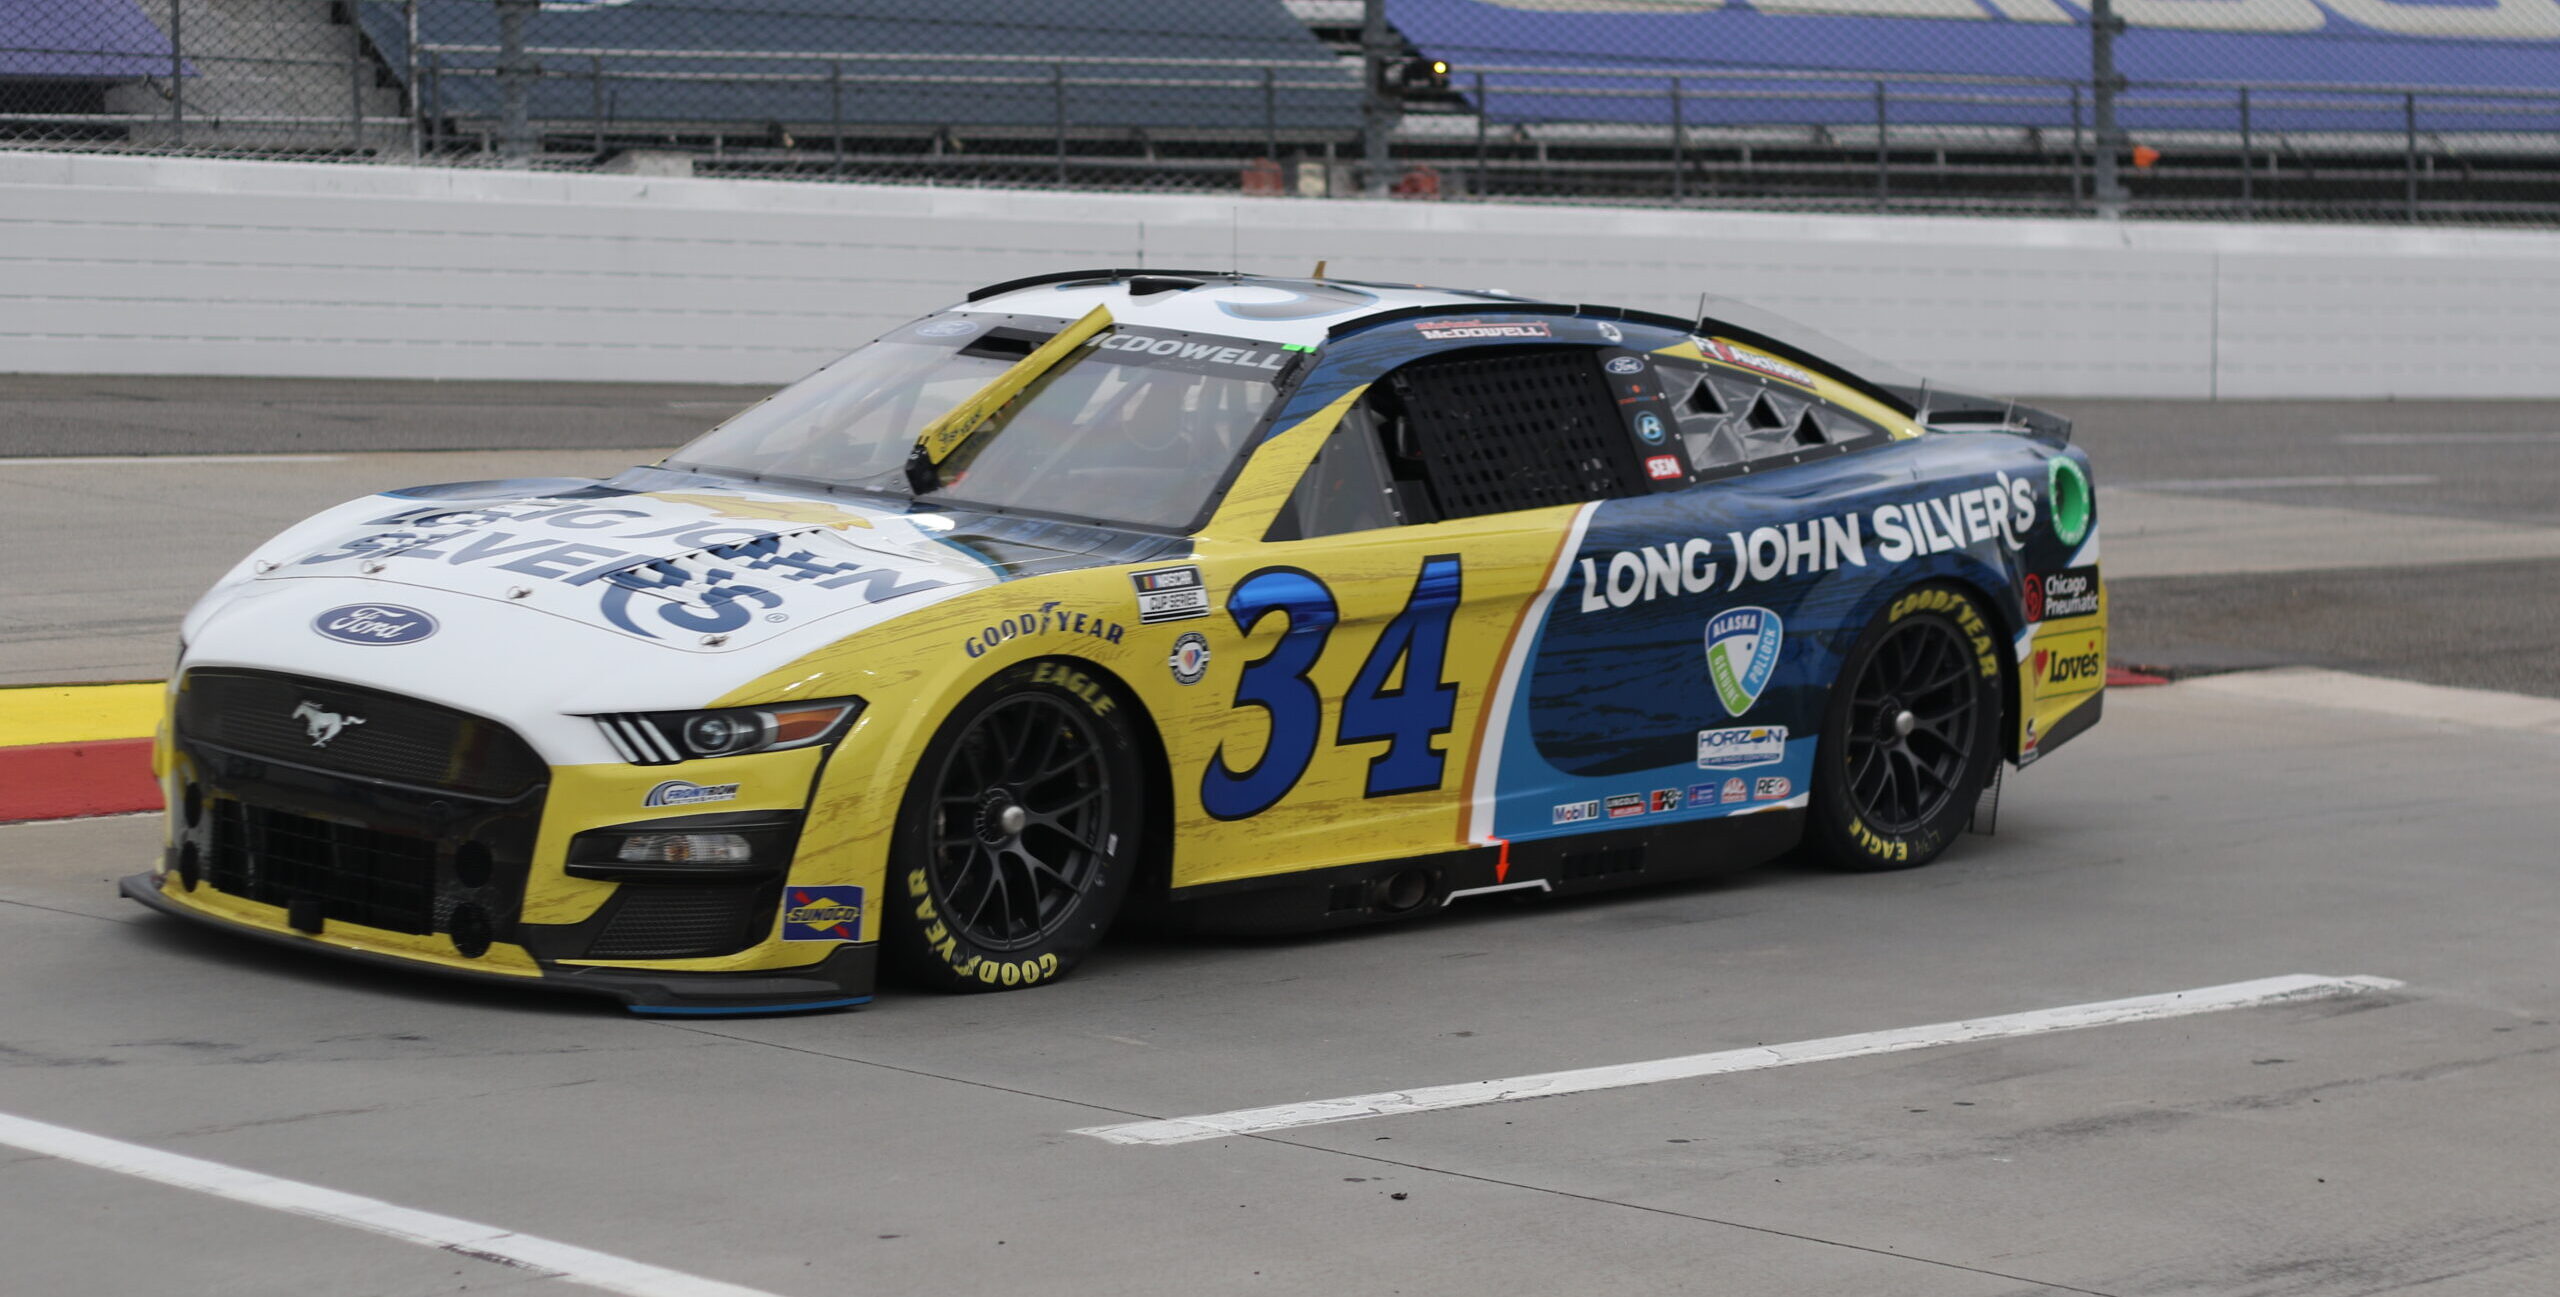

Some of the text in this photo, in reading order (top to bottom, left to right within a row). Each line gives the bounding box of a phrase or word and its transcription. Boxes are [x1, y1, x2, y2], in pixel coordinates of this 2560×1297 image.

[360, 500, 652, 530] LONG
[1580, 539, 1717, 613] LONG
[1727, 512, 1867, 592] JOHN
[1873, 470, 2036, 562] SILVER'S
[1156, 570, 1193, 588] NASCAR
[2045, 574, 2087, 597] Chicago
[1150, 591, 1199, 611] CUP SERIES
[2045, 594, 2099, 617] Pneumatic
[329, 608, 417, 639] Ford
[965, 601, 1126, 660] GOODYEAR
[1712, 614, 1757, 638] ALASKA
[1889, 589, 1999, 679] GOODYEAR
[1748, 628, 1777, 684] POLLOCK
[1032, 662, 1117, 717] EAGLE
[1201, 553, 1462, 822] 34
[1714, 654, 1741, 706] GENUINE
[1700, 728, 1782, 747] HORIZON
[1554, 804, 1587, 820] Mobil
[1849, 817, 1908, 861] EAGLE
[786, 906, 860, 923] SUNOCO
[907, 866, 1058, 986] GOODYEAR
